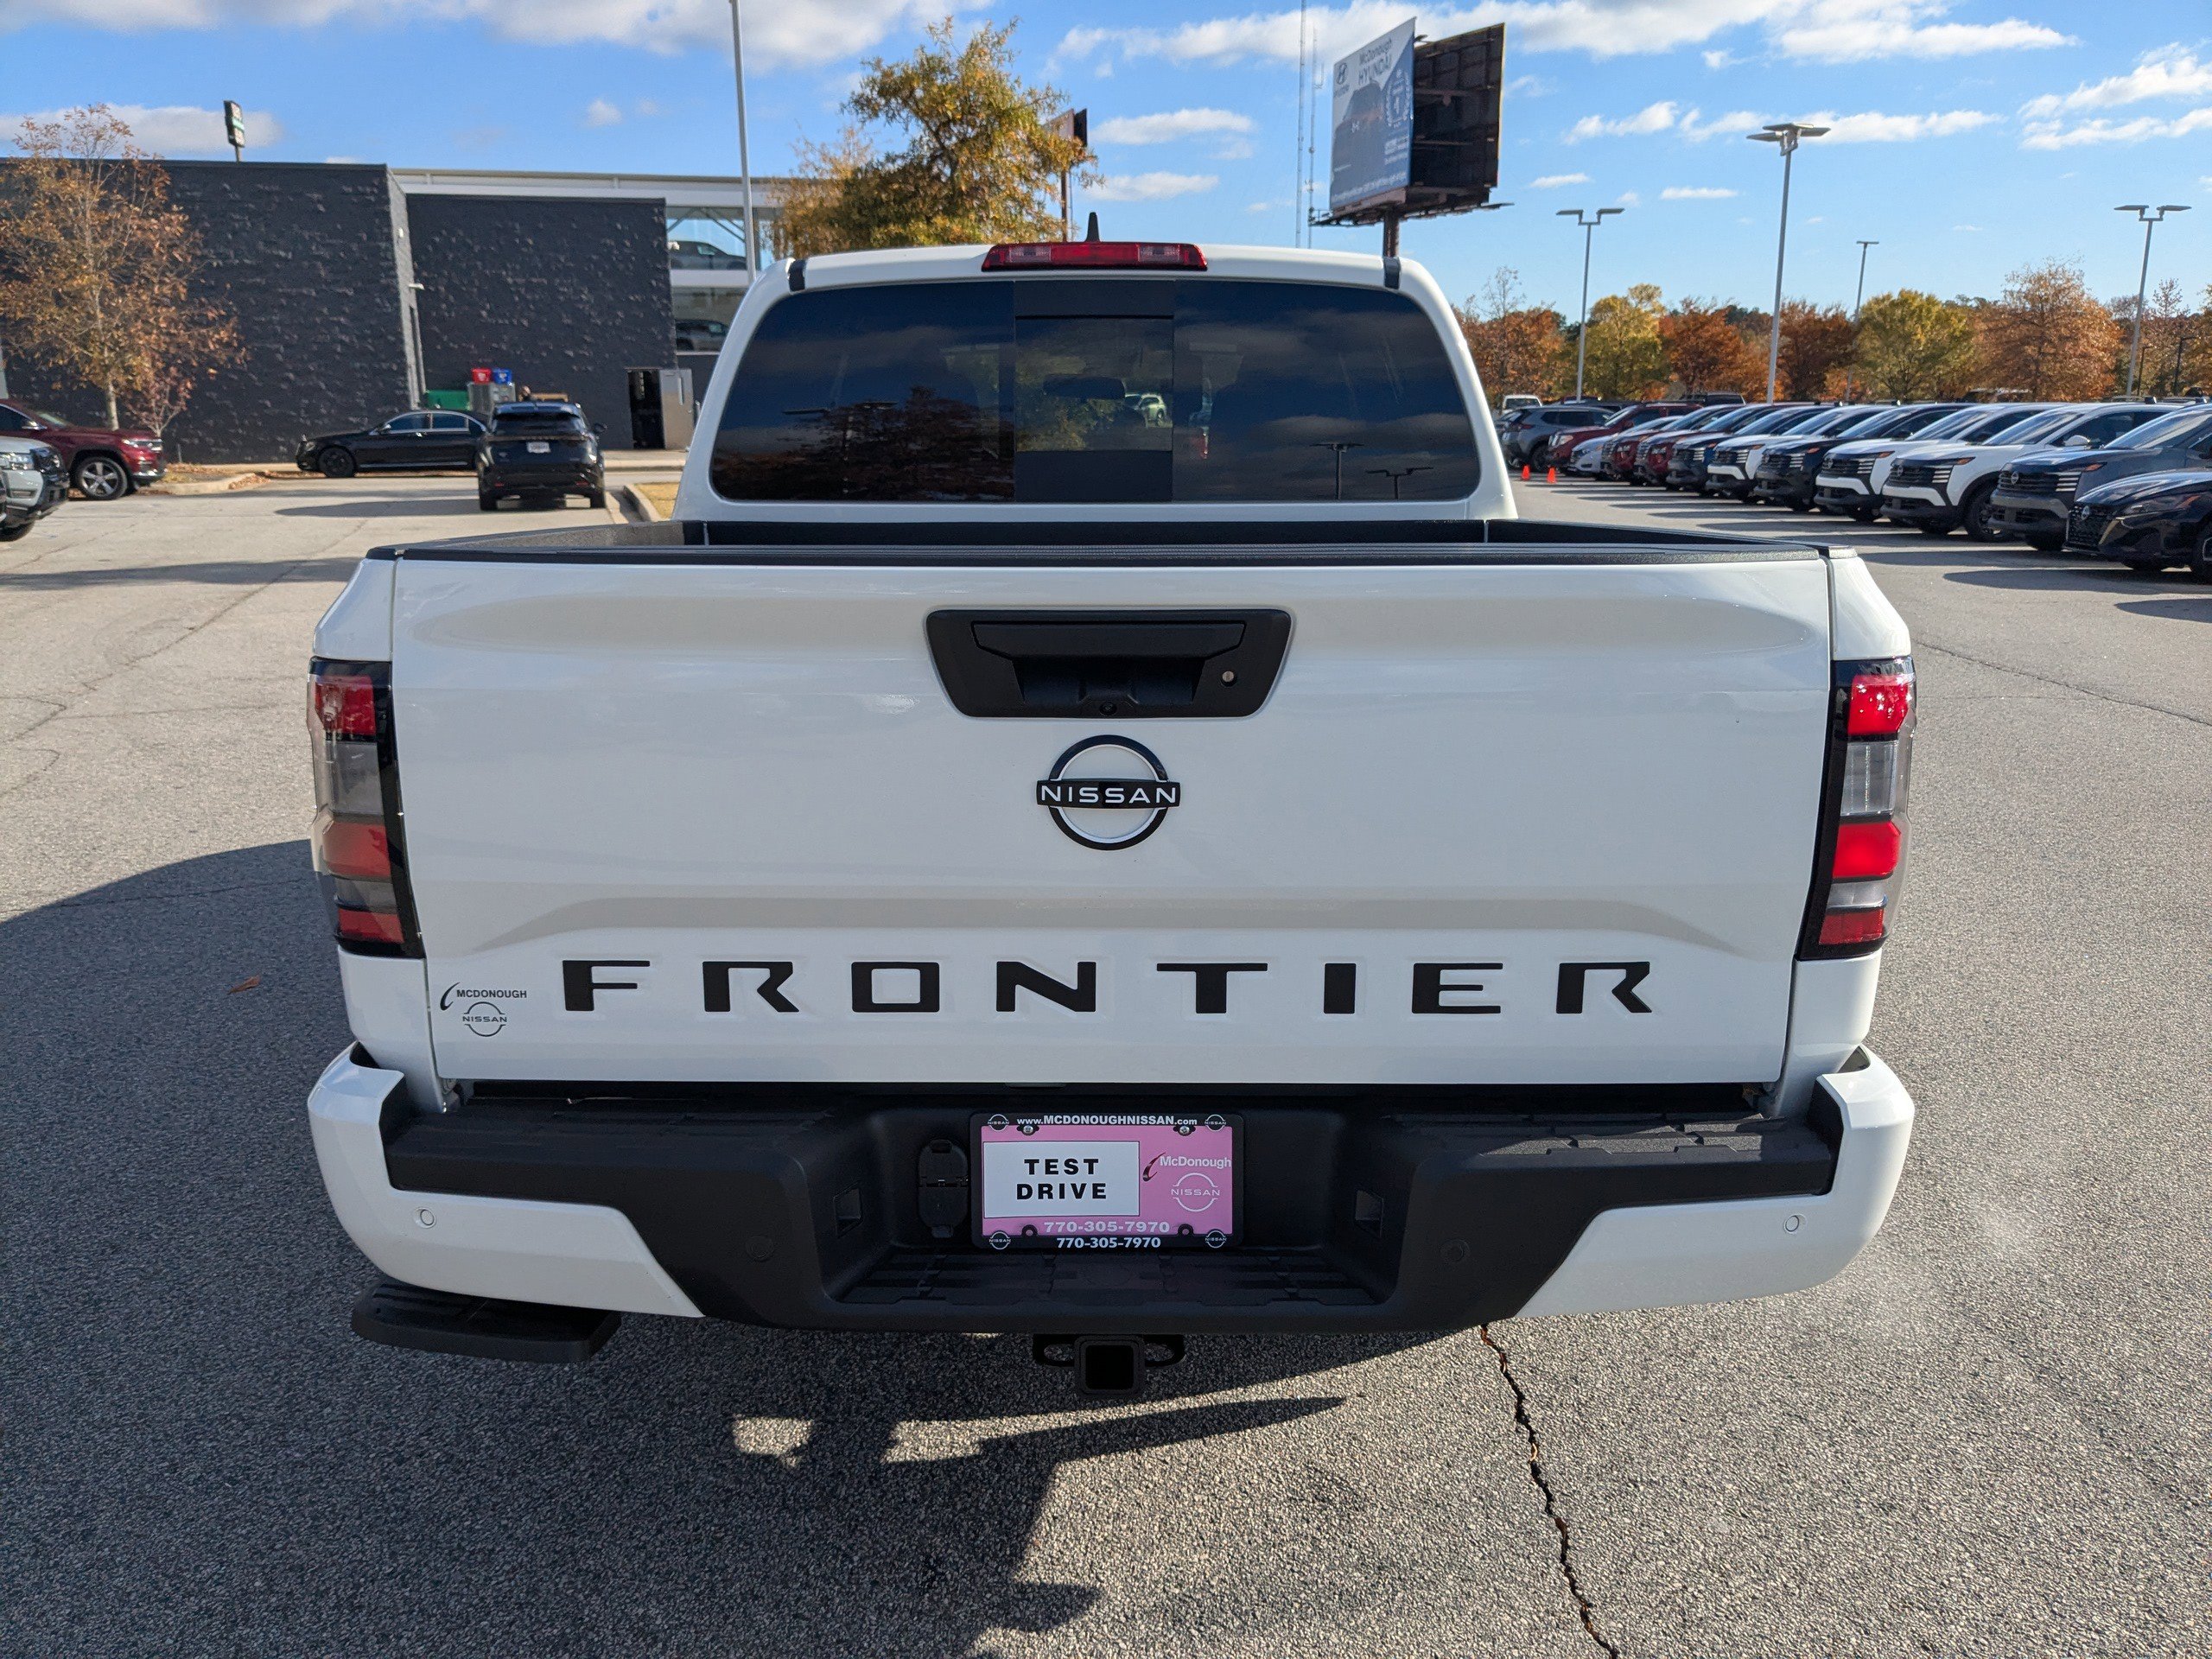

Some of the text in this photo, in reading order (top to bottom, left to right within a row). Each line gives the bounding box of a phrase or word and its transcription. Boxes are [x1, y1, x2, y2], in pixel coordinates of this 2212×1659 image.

[1041, 785, 1176, 804] NISSAN
[456, 989, 527, 998] MCDONOUGH
[563, 960, 1652, 1014] FRONTIER
[1017, 1115, 1198, 1126] www.MCDONOUGHNISSAN.com
[1024, 1158, 1099, 1175] TEST
[1160, 1156, 1232, 1169] McDonough
[1016, 1183, 1107, 1199] DRIVE
[1044, 1221, 1170, 1233] 770-305-7970
[1056, 1237, 1161, 1249] 770-305-7970
